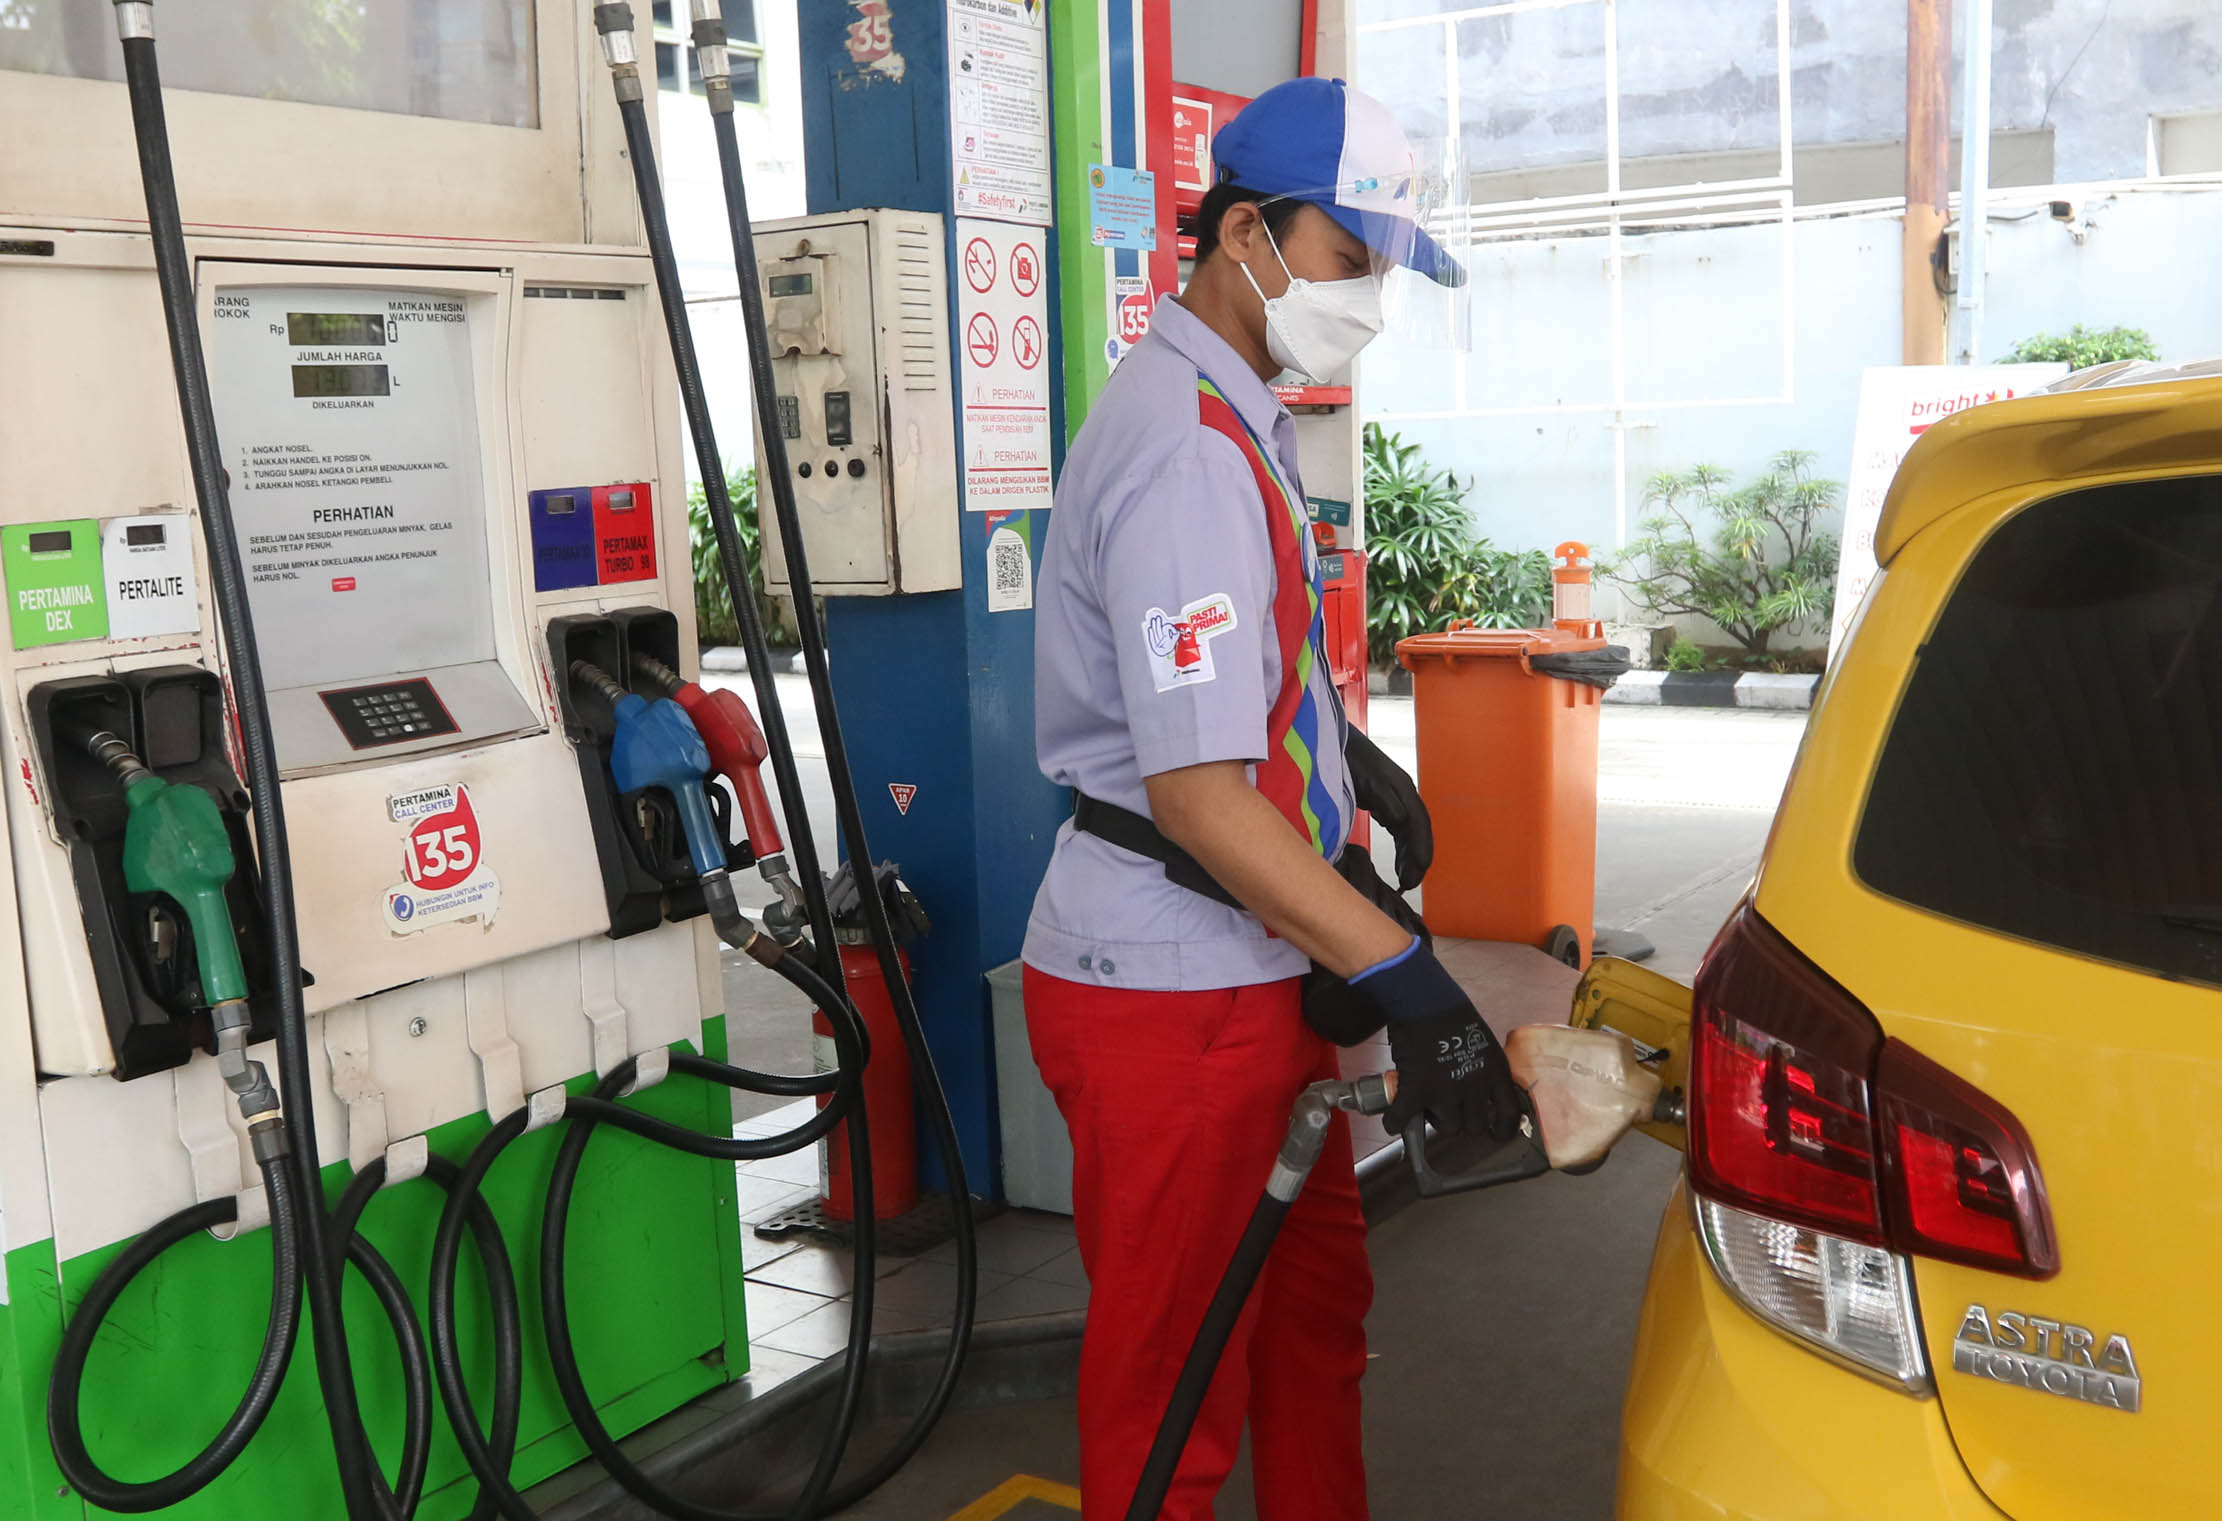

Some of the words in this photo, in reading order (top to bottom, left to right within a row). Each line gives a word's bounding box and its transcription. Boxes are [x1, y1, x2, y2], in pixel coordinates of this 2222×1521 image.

[858, 16, 890, 51] 35
[388, 302, 431, 312] MATIKAN
[434, 303, 463, 312] MESIN
[390, 313, 424, 322] WAKTU
[427, 313, 466, 323] MENGISI
[1120, 305, 1149, 336] 135
[270, 324, 285, 335] Rp
[297, 352, 342, 362] JUMLAH
[345, 352, 383, 361] HARGA
[393, 376, 400, 387] L
[992, 388, 1035, 400] PERHATIAN
[312, 401, 375, 409] DIKELUARKAN
[252, 445, 283, 454] ANGKAT
[994, 450, 1037, 461] PERHATIAN
[253, 457, 288, 466] NAIKKAN
[290, 456, 320, 465] HANDEL
[322, 455, 332, 463] KE
[334, 454, 358, 462] POSISI
[254, 469, 287, 478] TUNGGU
[289, 468, 317, 477] SAMPAI
[319, 466, 345, 475] ANGKA
[346, 466, 354, 474] DI
[355, 464, 379, 473] LAYAR
[255, 480, 293, 490] ARAHKAN
[295, 479, 320, 488] NOSEL
[313, 505, 394, 523] PERHATIAN
[249, 534, 287, 544] SEBELUM
[289, 533, 305, 541] DAN
[307, 531, 342, 540] SESUDAH
[344, 526, 397, 537] PENGELUARAN
[429, 522, 453, 531] GELAS
[250, 545, 278, 554] HARUS
[280, 543, 303, 552] TETAP
[603, 536, 648, 553] PERTAMAX
[252, 562, 289, 573] SEBELUM
[291, 560, 320, 569] MINYAK
[321, 554, 374, 567] DIKELUARKAN
[375, 552, 400, 562] ANGKA
[401, 549, 437, 560] PENUNJUK
[605, 557, 634, 573] TURBO
[253, 573, 281, 583] HARUS
[119, 576, 183, 600] PERTALITE
[19, 584, 94, 611] PERTAMINA
[46, 610, 73, 632] DEX
[393, 788, 452, 808] PERTAMINA
[898, 793, 908, 803] 10
[395, 808, 418, 819] CALL
[420, 799, 455, 814] CENTER
[405, 825, 474, 882] 135
[453, 886, 477, 897] UNTUK
[1957, 1303, 2140, 1378] ASTRA
[1966, 1347, 2121, 1409] TOYOTA
